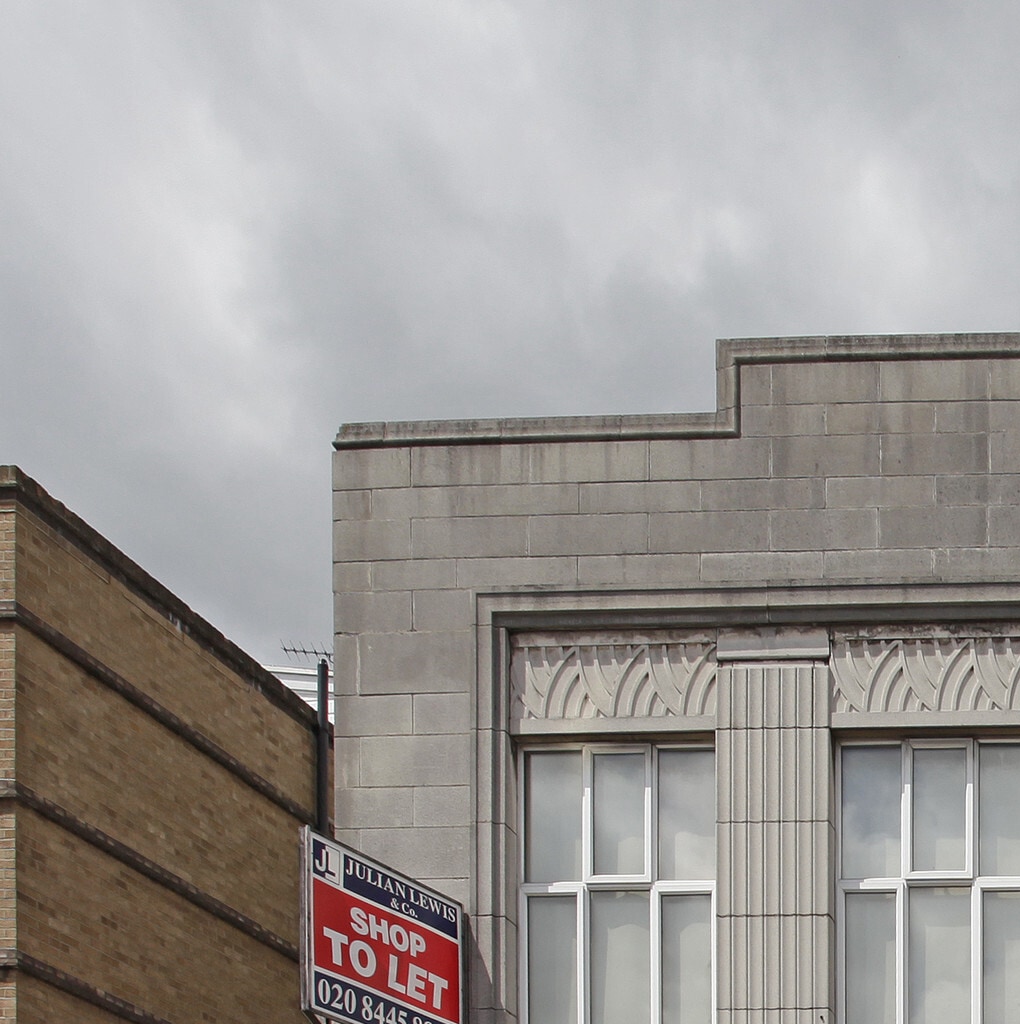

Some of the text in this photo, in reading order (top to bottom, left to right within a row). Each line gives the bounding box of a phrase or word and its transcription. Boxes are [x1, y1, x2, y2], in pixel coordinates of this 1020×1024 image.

[346, 858, 457, 923] JULIAN LEWIS
[390, 897, 418, 918] & Co.
[350, 907, 427, 958] SHOP
[322, 926, 449, 1011] TO LET
[317, 977, 358, 1015] 020
